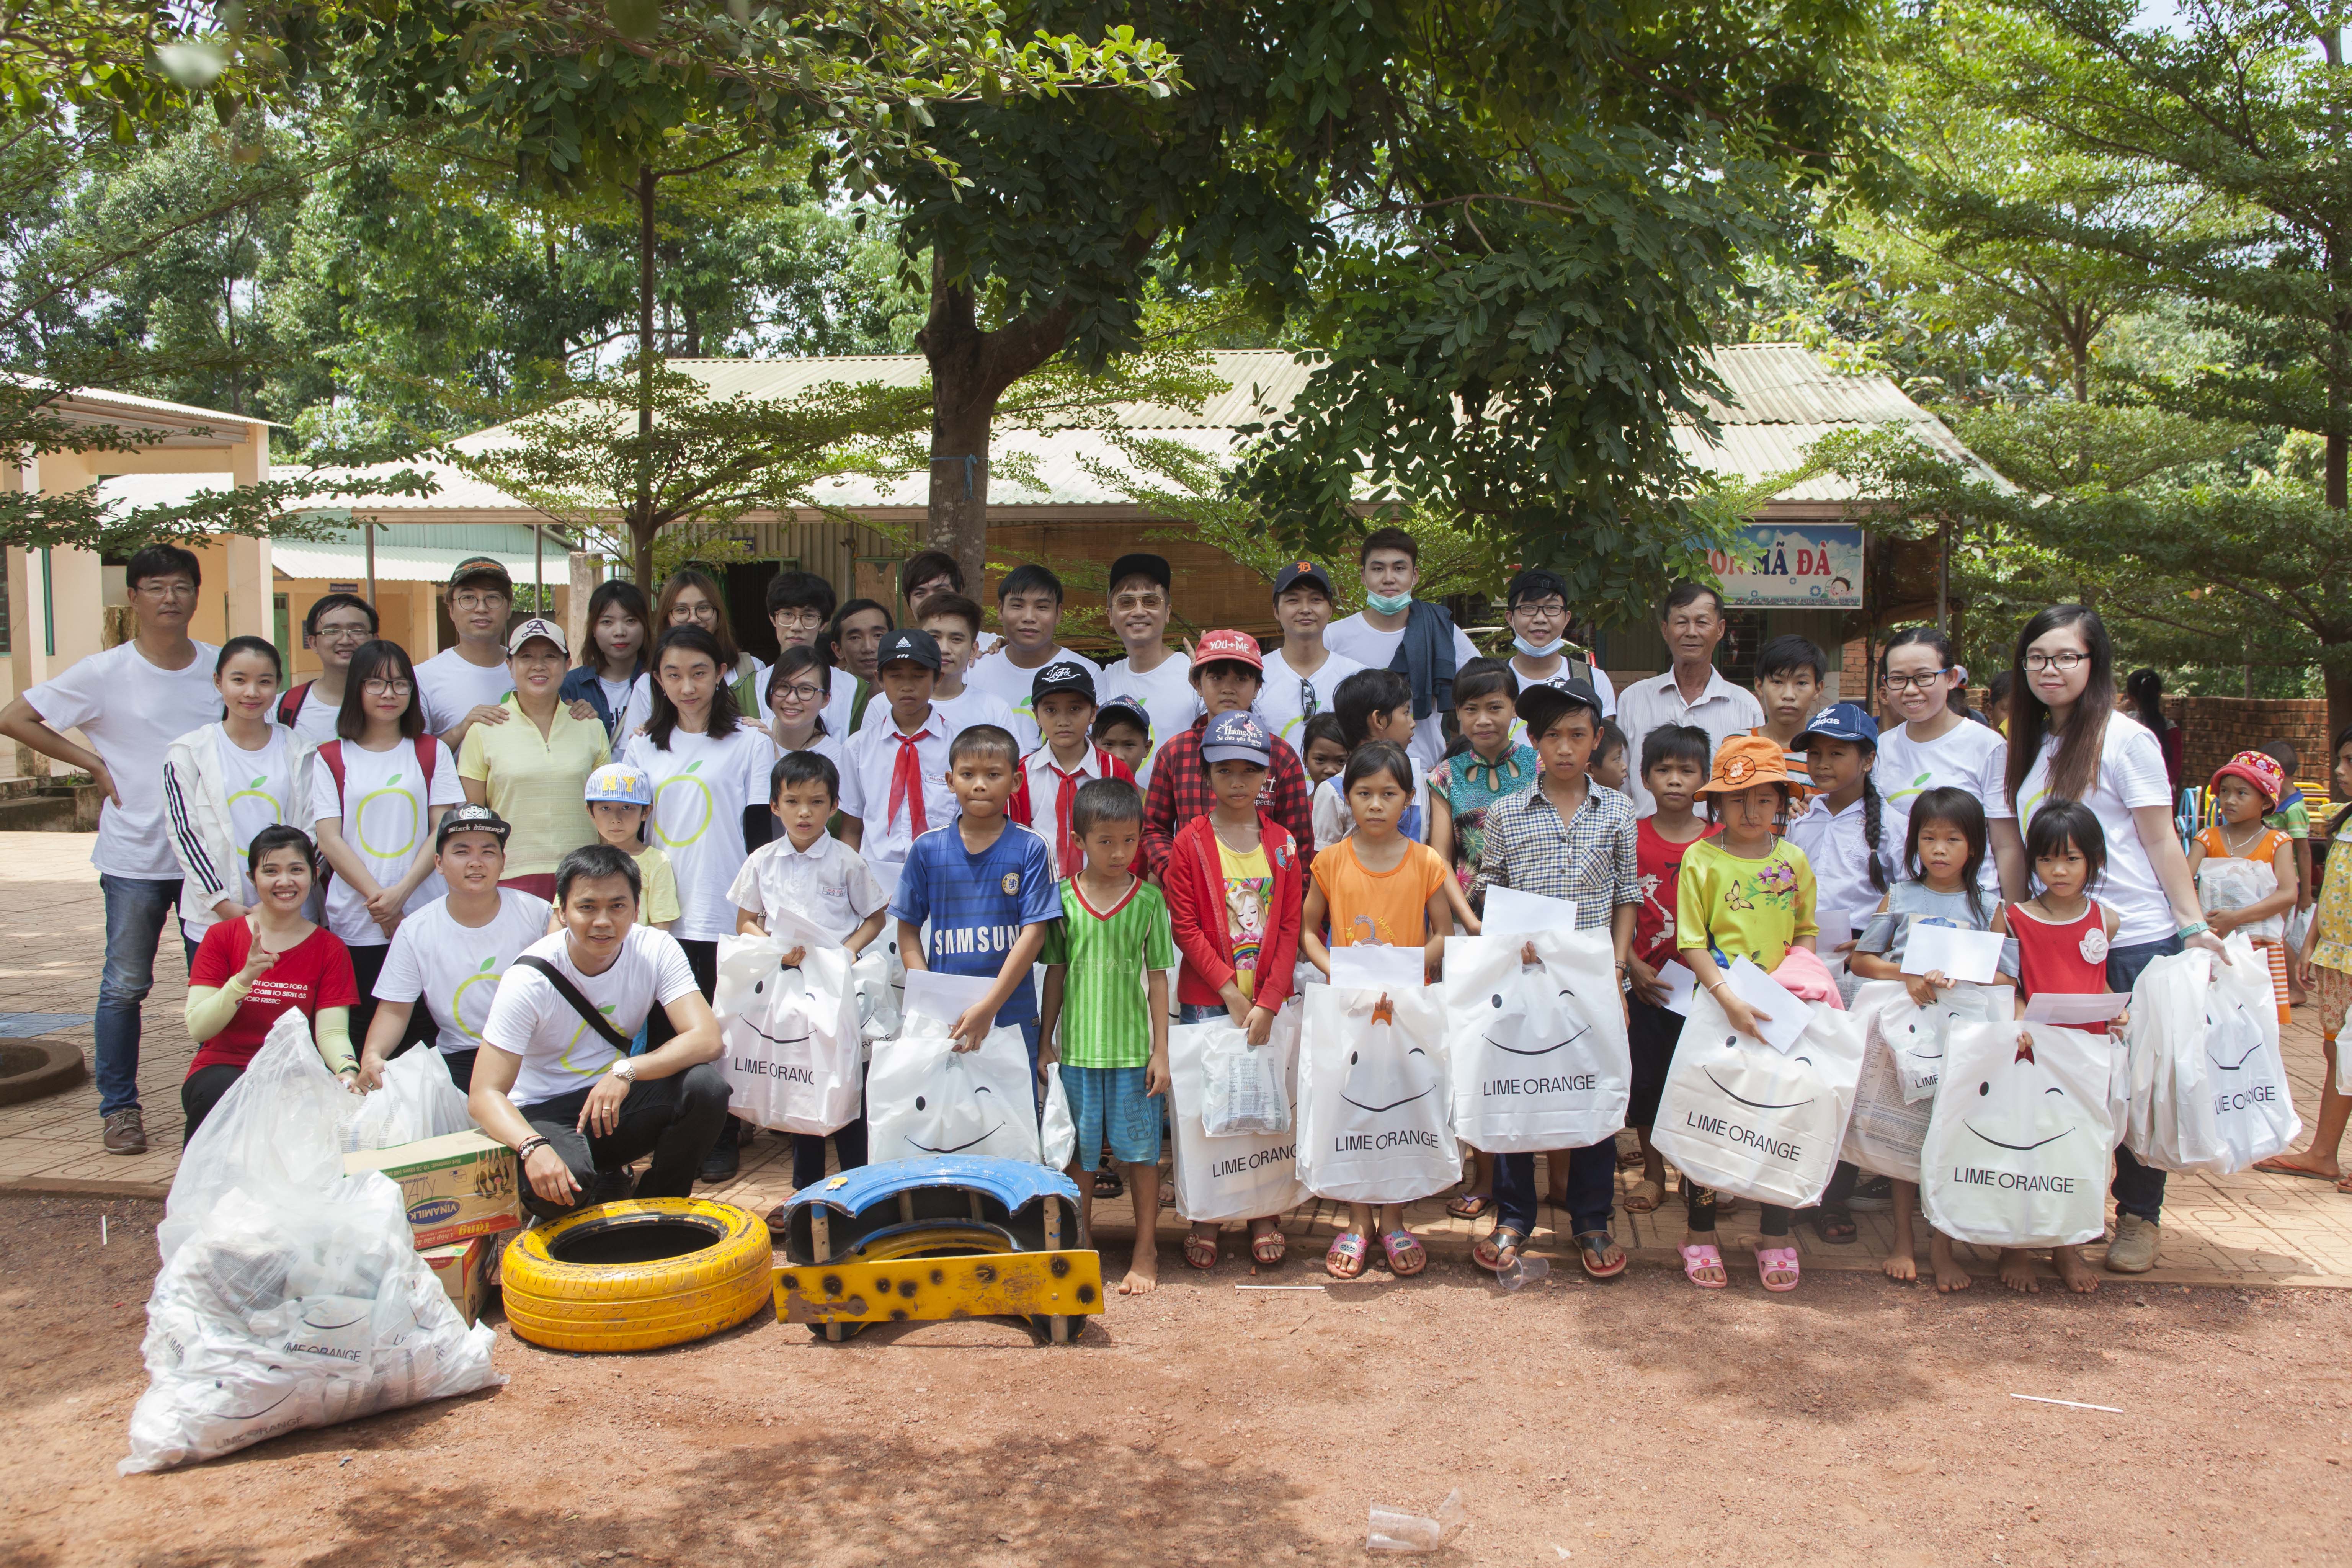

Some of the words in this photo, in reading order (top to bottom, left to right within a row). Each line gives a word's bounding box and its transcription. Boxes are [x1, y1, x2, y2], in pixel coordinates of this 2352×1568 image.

[1796, 541, 1831, 575] ĐÀ
[522, 620, 549, 638] A
[1215, 718, 1233, 733] Nhóm
[935, 924, 1020, 956] SAMSUN
[1377, 916, 1397, 940] HAPPY
[735, 1057, 767, 1075] LIME
[769, 1063, 814, 1085] ORAN
[1483, 1079, 1521, 1096] LIME
[1523, 1075, 1596, 1095] ORANGE
[1335, 1135, 1373, 1152] LIME
[1375, 1130, 1439, 1150] ORANGE
[1687, 1111, 1727, 1136] LIME
[1728, 1125, 1802, 1162] ORANGE
[1212, 1156, 1246, 1178] LIME
[1248, 1143, 1297, 1169] ORANG
[1954, 1167, 1996, 1186] LIME
[1998, 1173, 2074, 1194] ORANGE
[409, 1203, 458, 1220] VINAMILK
